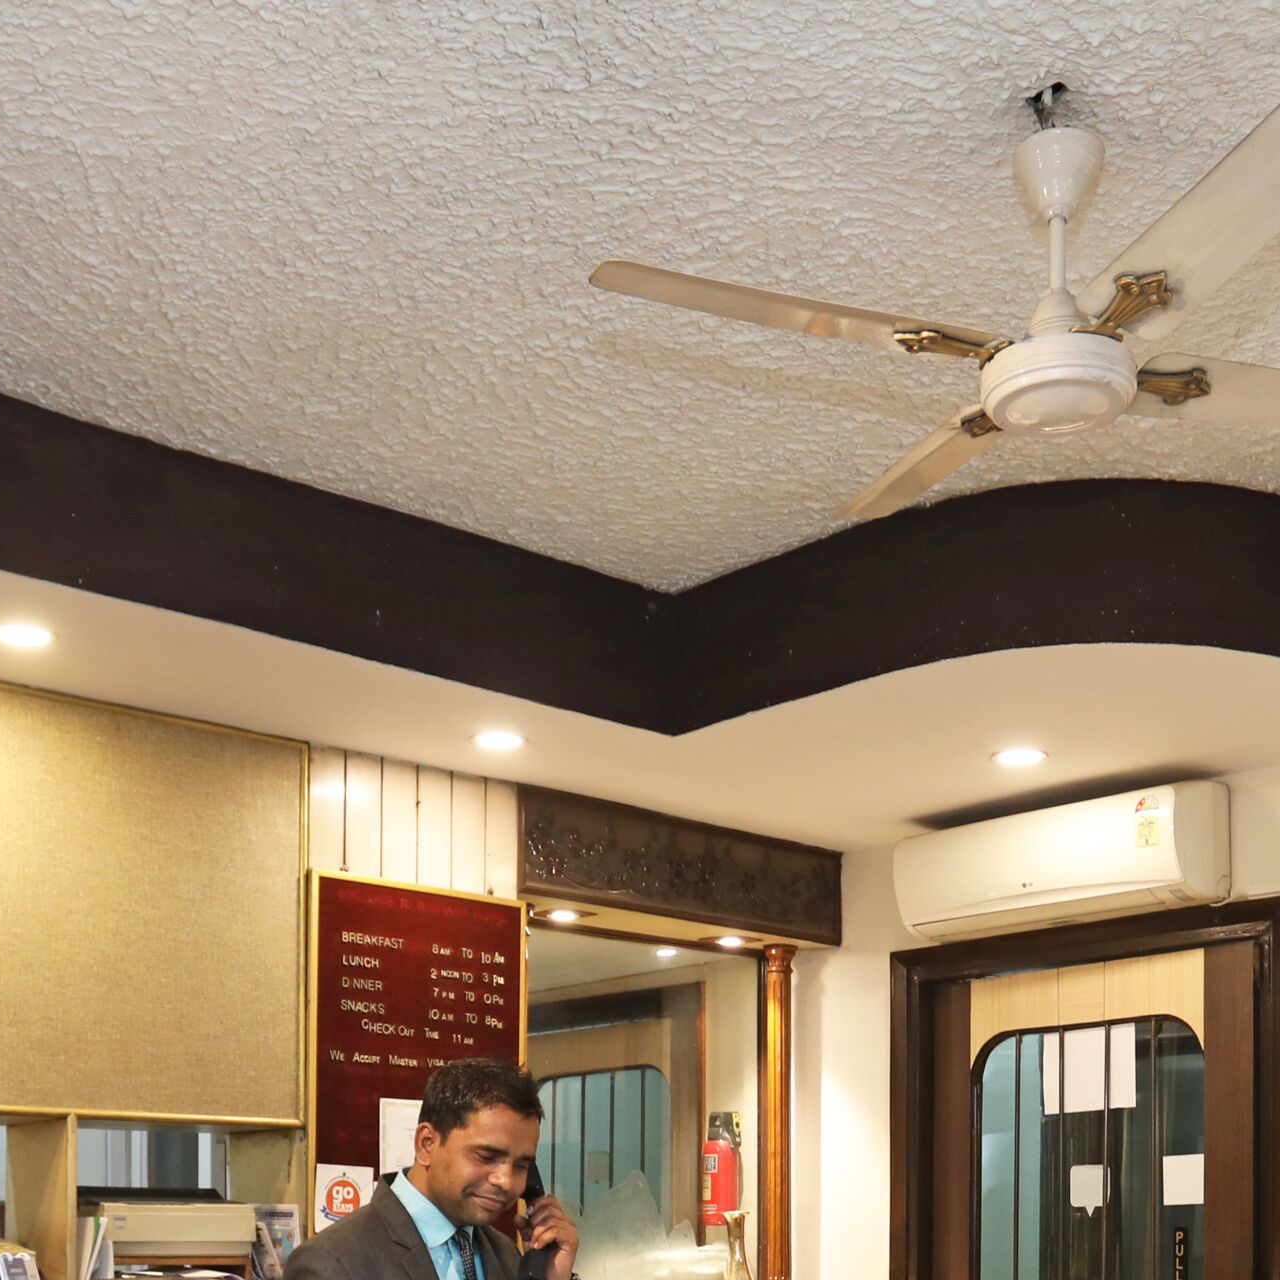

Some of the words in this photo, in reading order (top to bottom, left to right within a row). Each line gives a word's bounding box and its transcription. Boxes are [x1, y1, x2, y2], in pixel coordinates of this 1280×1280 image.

[341, 931, 404, 950] BREAKFAST
[461, 947, 474, 959] TO
[342, 954, 380, 969] LUNCH
[461, 972, 474, 984] TO
[482, 972, 489, 983] 3
[341, 976, 383, 992] DNNER
[433, 987, 439, 998] 7
[441, 991, 455, 1000] PM
[464, 991, 475, 1002] TO
[340, 999, 385, 1015] SNACKS
[441, 1013, 454, 1022] AM
[465, 1013, 478, 1025] TO
[361, 1018, 396, 1035] CHECK
[397, 1025, 415, 1037] OUT
[423, 1027, 440, 1040] TIME
[452, 1033, 462, 1044] 11
[463, 1037, 474, 1046] AM
[352, 1052, 381, 1064] ACCEPT
[388, 1054, 419, 1068] MASTER
[426, 1057, 445, 1069] VISA
[332, 1185, 355, 1203] go
